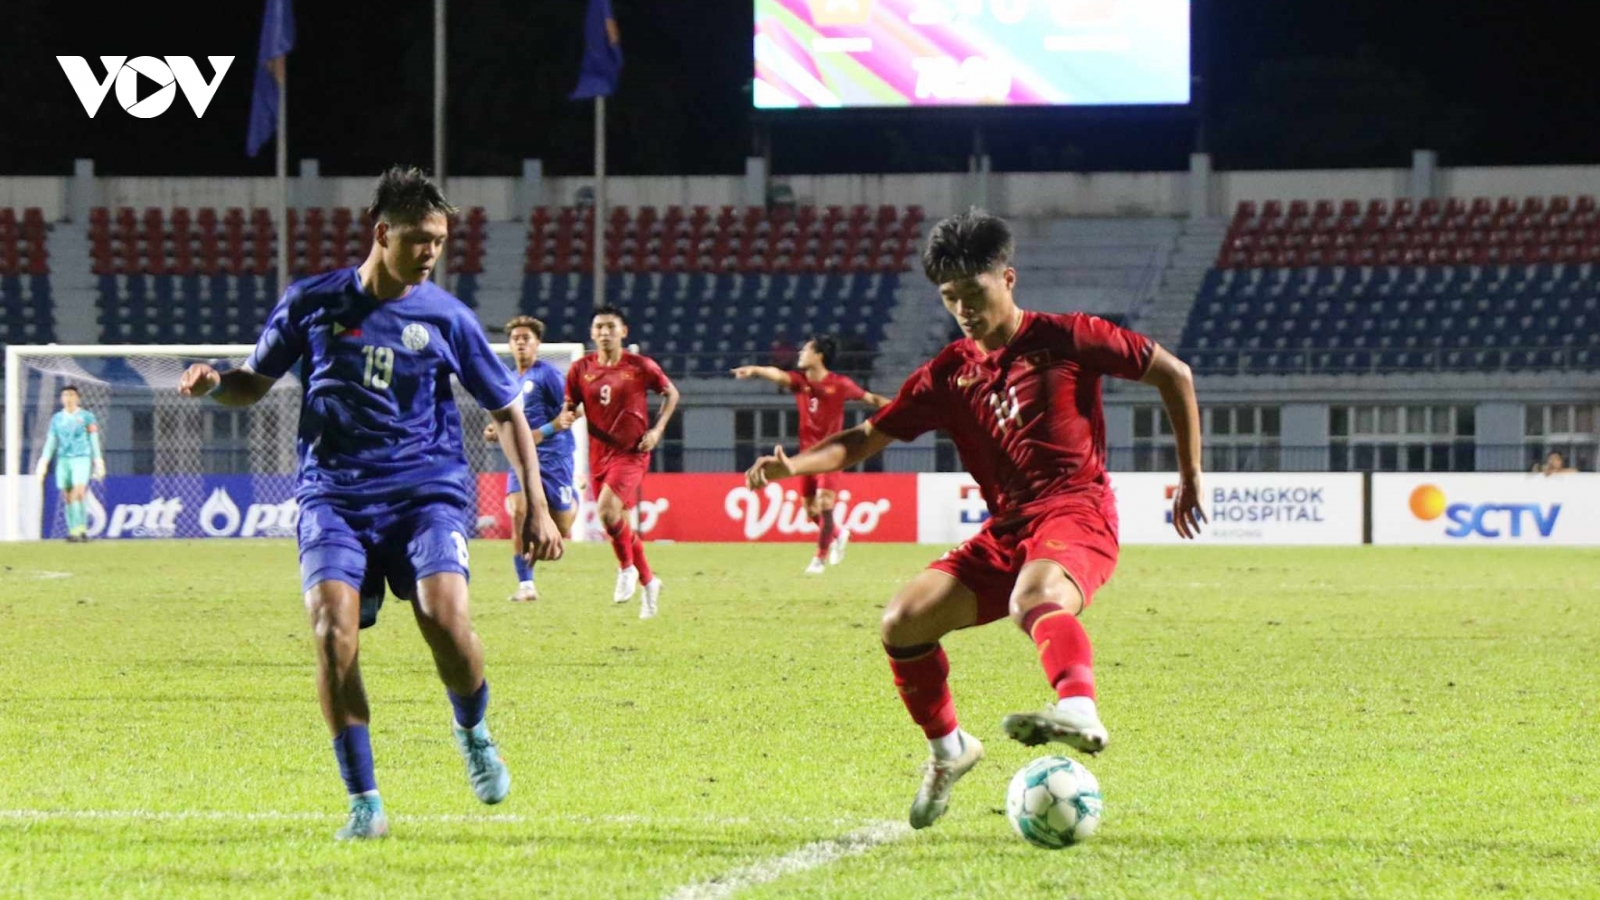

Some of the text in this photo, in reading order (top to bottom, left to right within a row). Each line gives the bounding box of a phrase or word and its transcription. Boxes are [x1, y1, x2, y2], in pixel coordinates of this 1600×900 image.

[361, 345, 395, 389] 19
[600, 384, 612, 406] 9
[808, 396, 819, 413] 3
[1213, 487, 1325, 503] BANGKOK
[106, 496, 184, 537] ptt
[725, 482, 892, 540] Viio
[1212, 505, 1325, 522] HOSPITAL
[1445, 502, 1562, 538] SCTV
